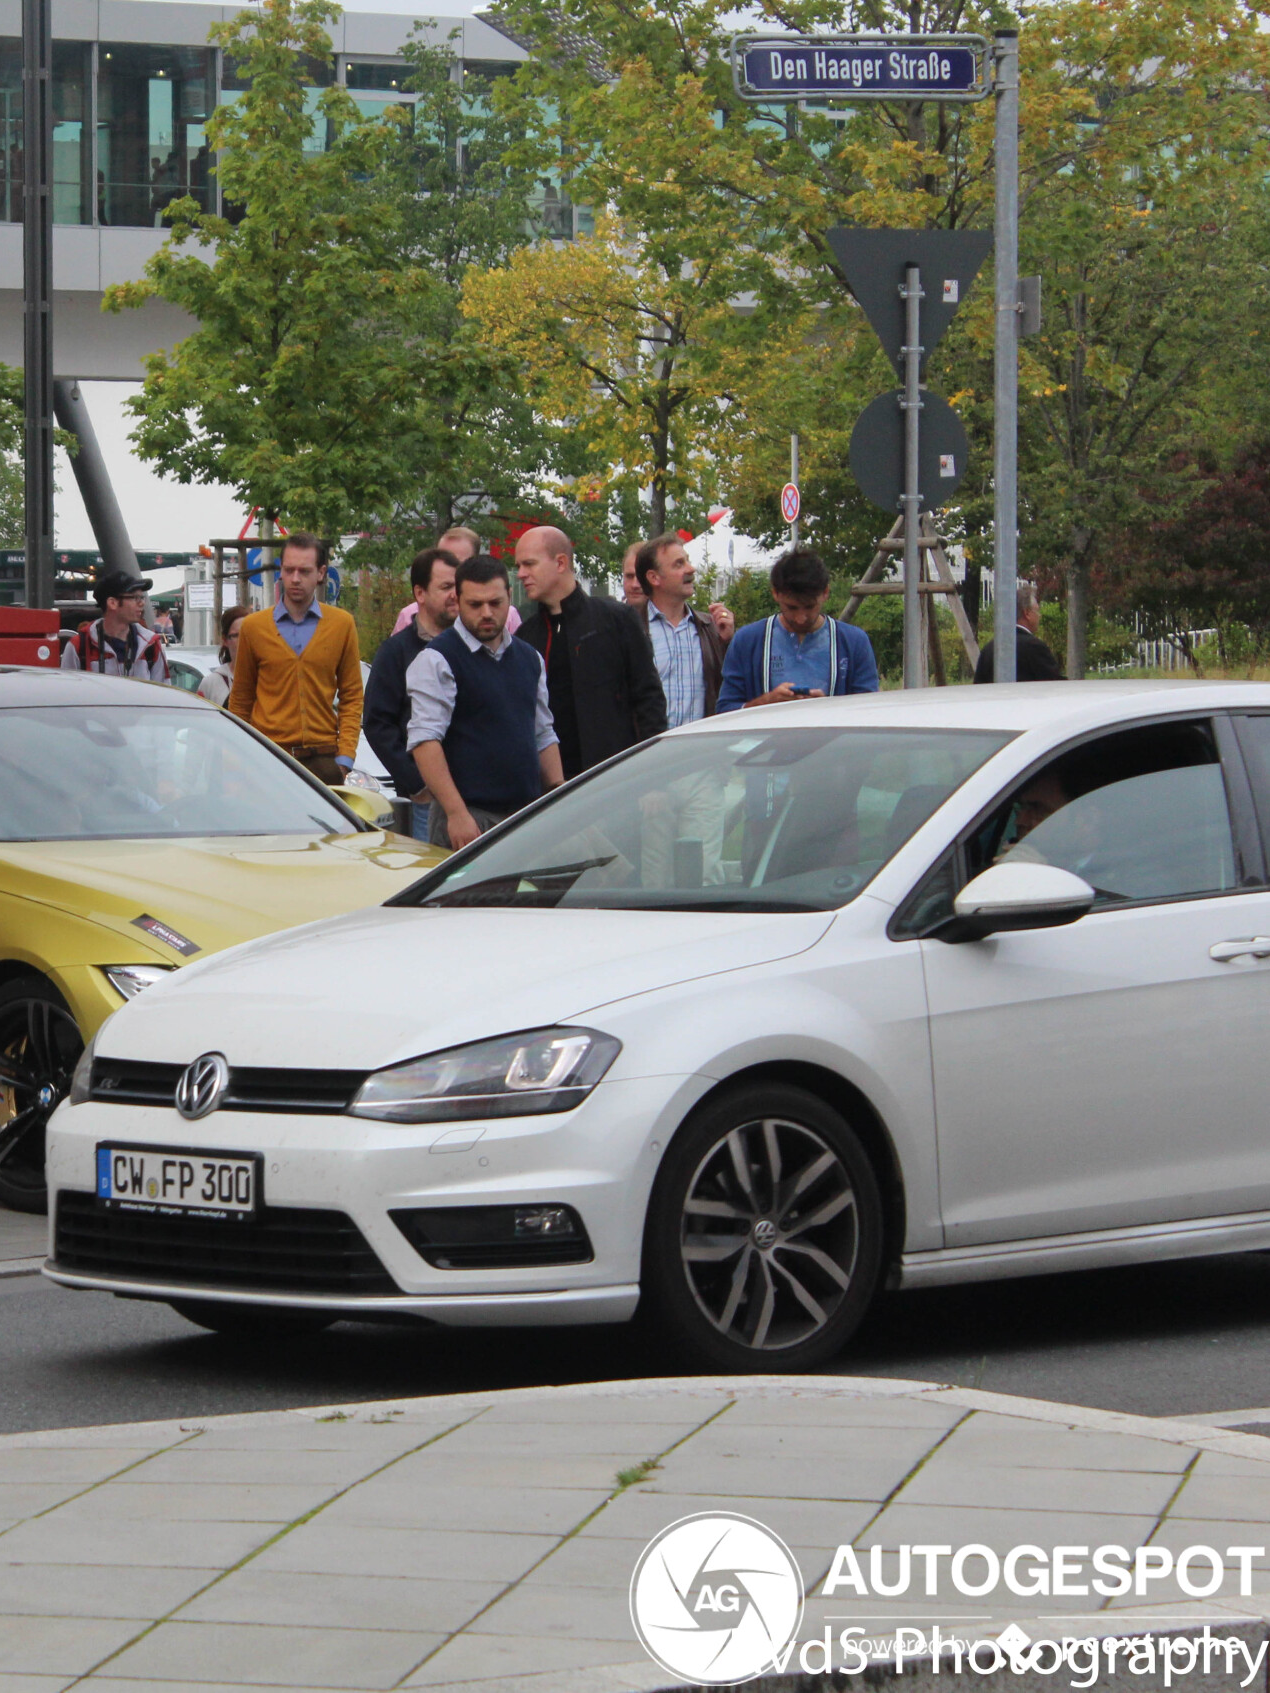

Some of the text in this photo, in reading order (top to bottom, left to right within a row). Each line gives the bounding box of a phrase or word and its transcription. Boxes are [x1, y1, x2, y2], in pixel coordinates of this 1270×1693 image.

[770, 51, 951, 87] Den Haager Straße
[114, 1155, 250, 1204] CW FP 300
